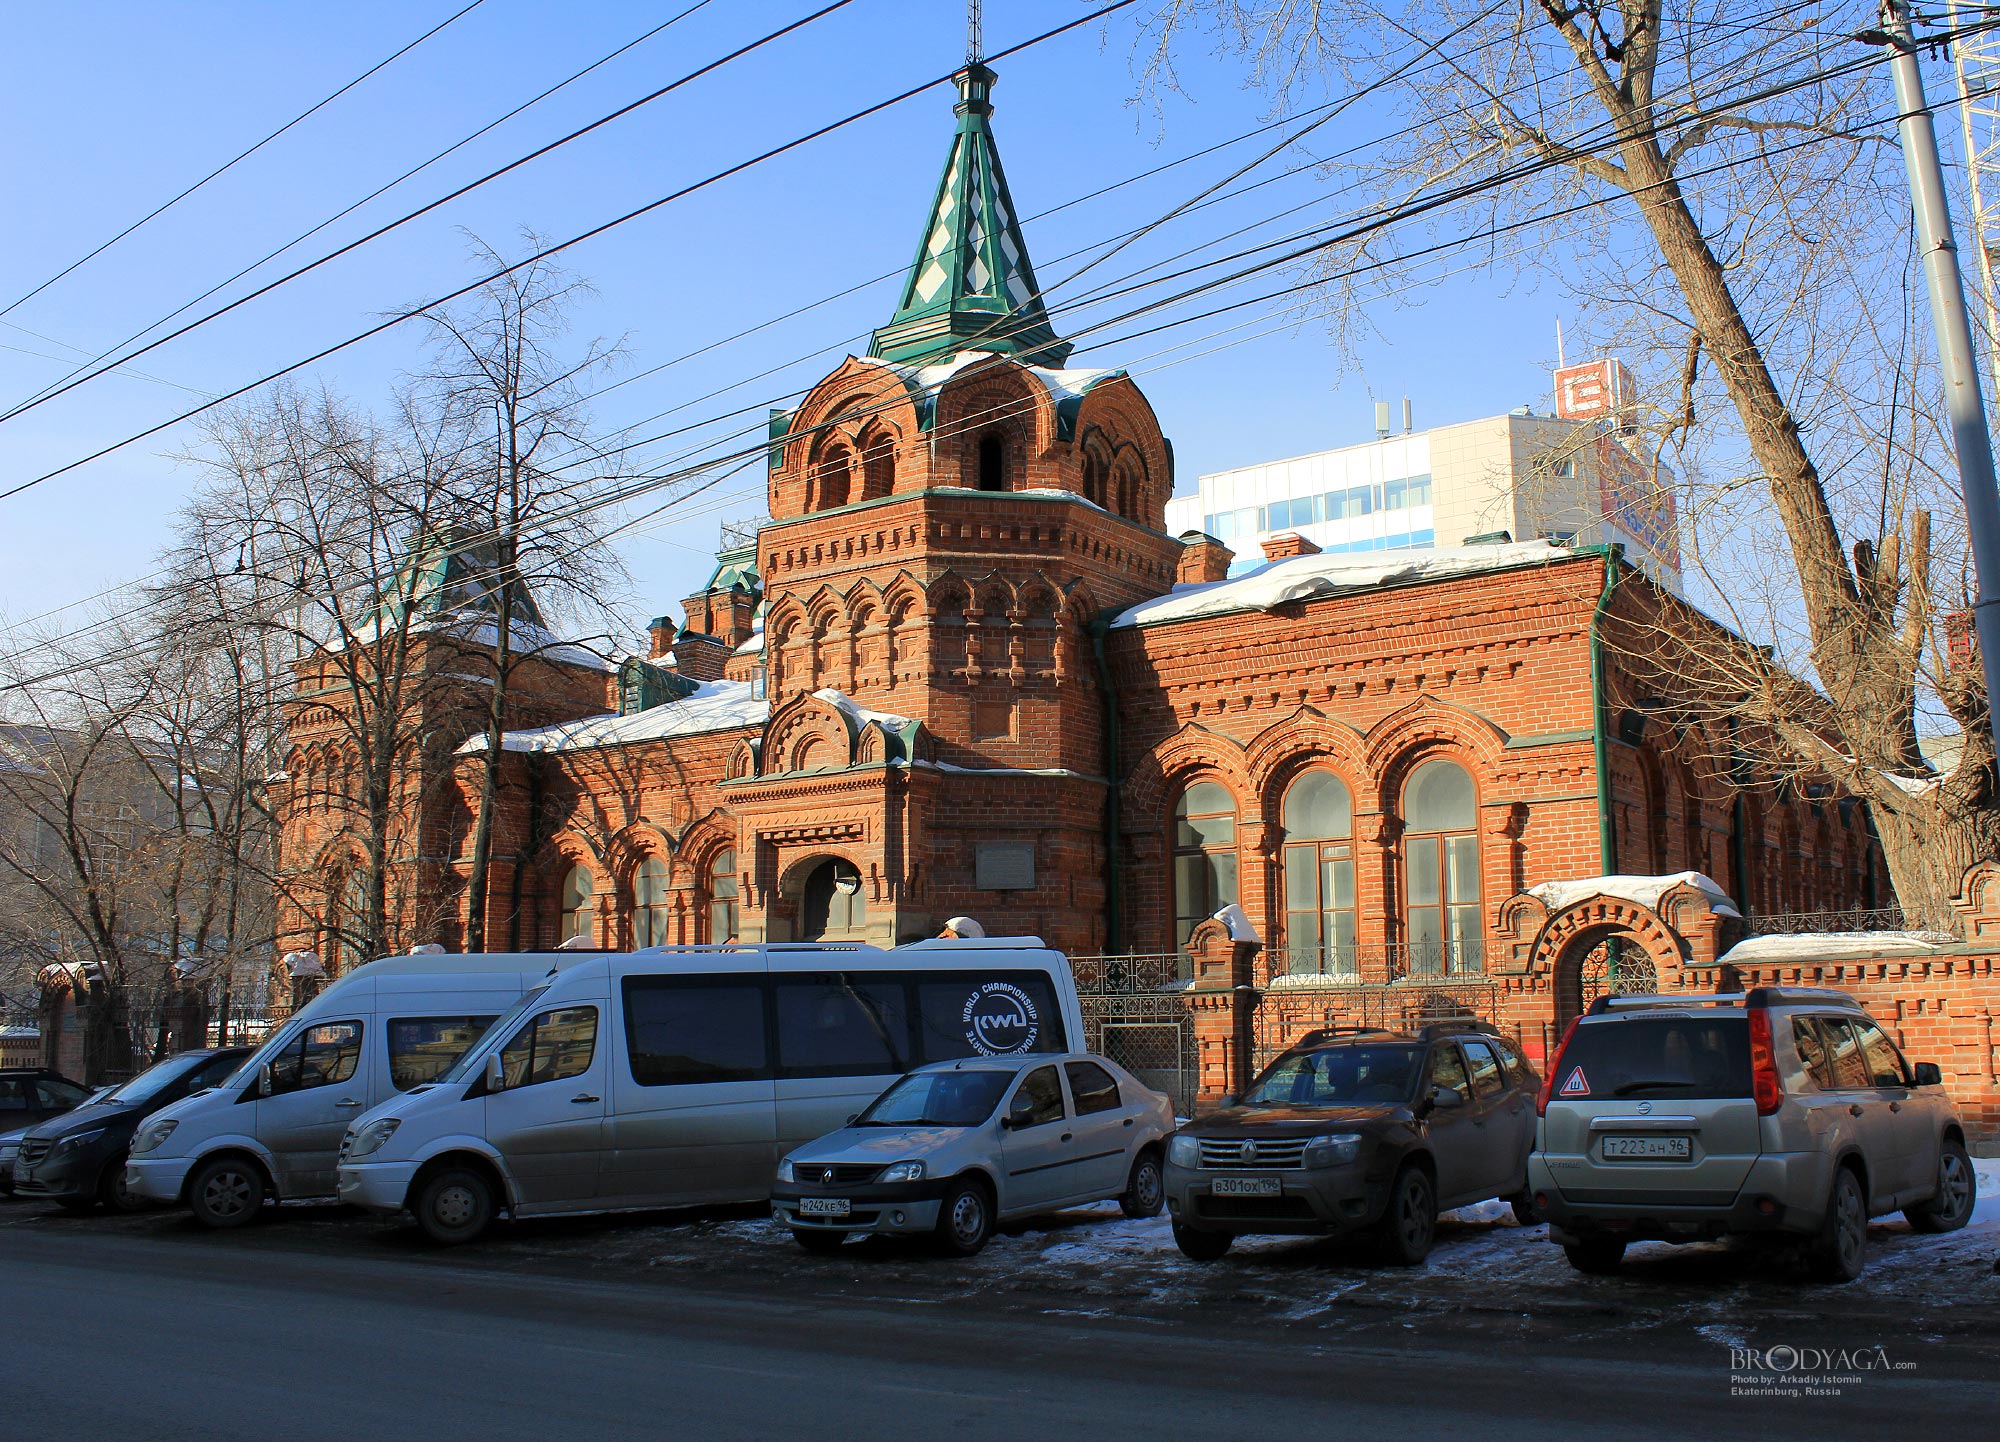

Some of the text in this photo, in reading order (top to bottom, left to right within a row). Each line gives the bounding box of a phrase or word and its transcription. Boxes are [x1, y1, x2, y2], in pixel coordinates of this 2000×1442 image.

[963, 991, 980, 1022] WORLD
[982, 982, 1038, 1020] CHAMPIONSHIP
[1570, 1081, 1580, 1090] Ш
